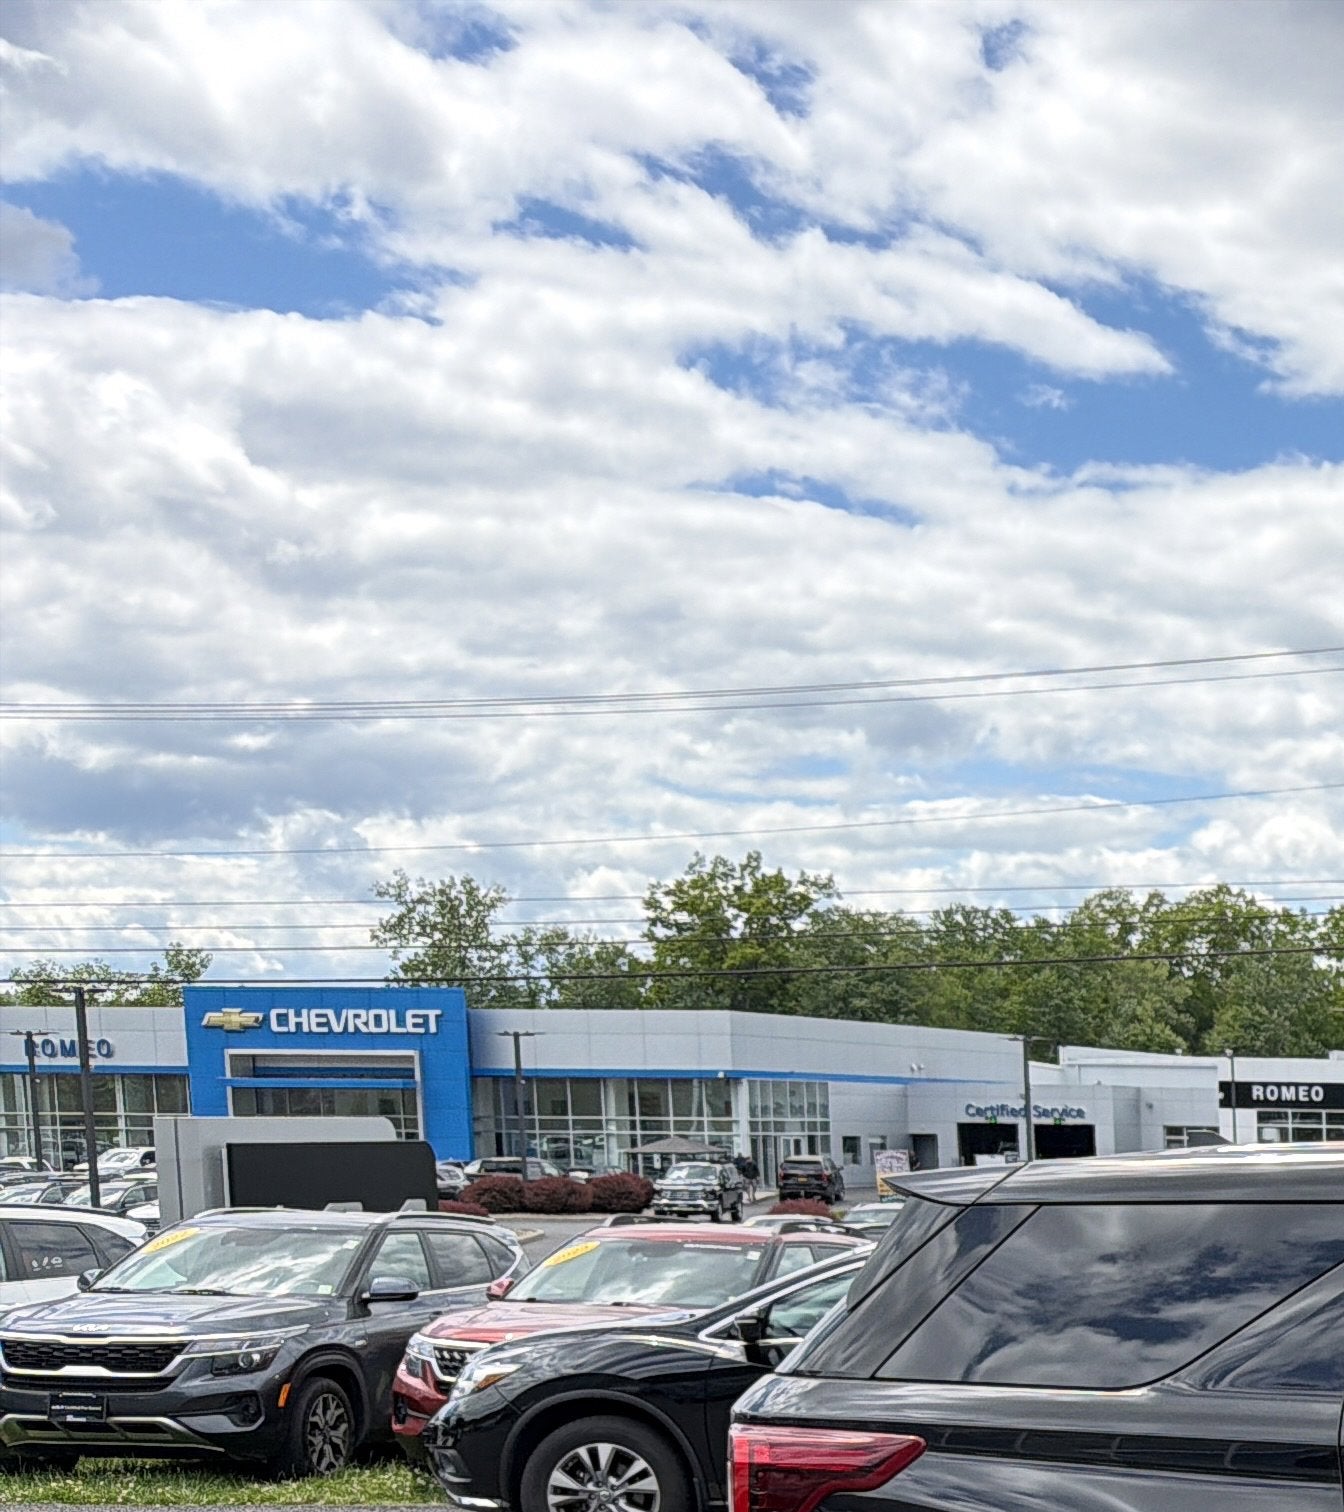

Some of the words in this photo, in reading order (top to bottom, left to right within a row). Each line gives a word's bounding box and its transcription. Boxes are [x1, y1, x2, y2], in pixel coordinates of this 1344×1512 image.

[269, 1008, 442, 1033] CHEVROLET
[1251, 1085, 1324, 1102] ROMEO
[965, 1103, 1027, 1118] Certified
[1032, 1104, 1086, 1119] Service
